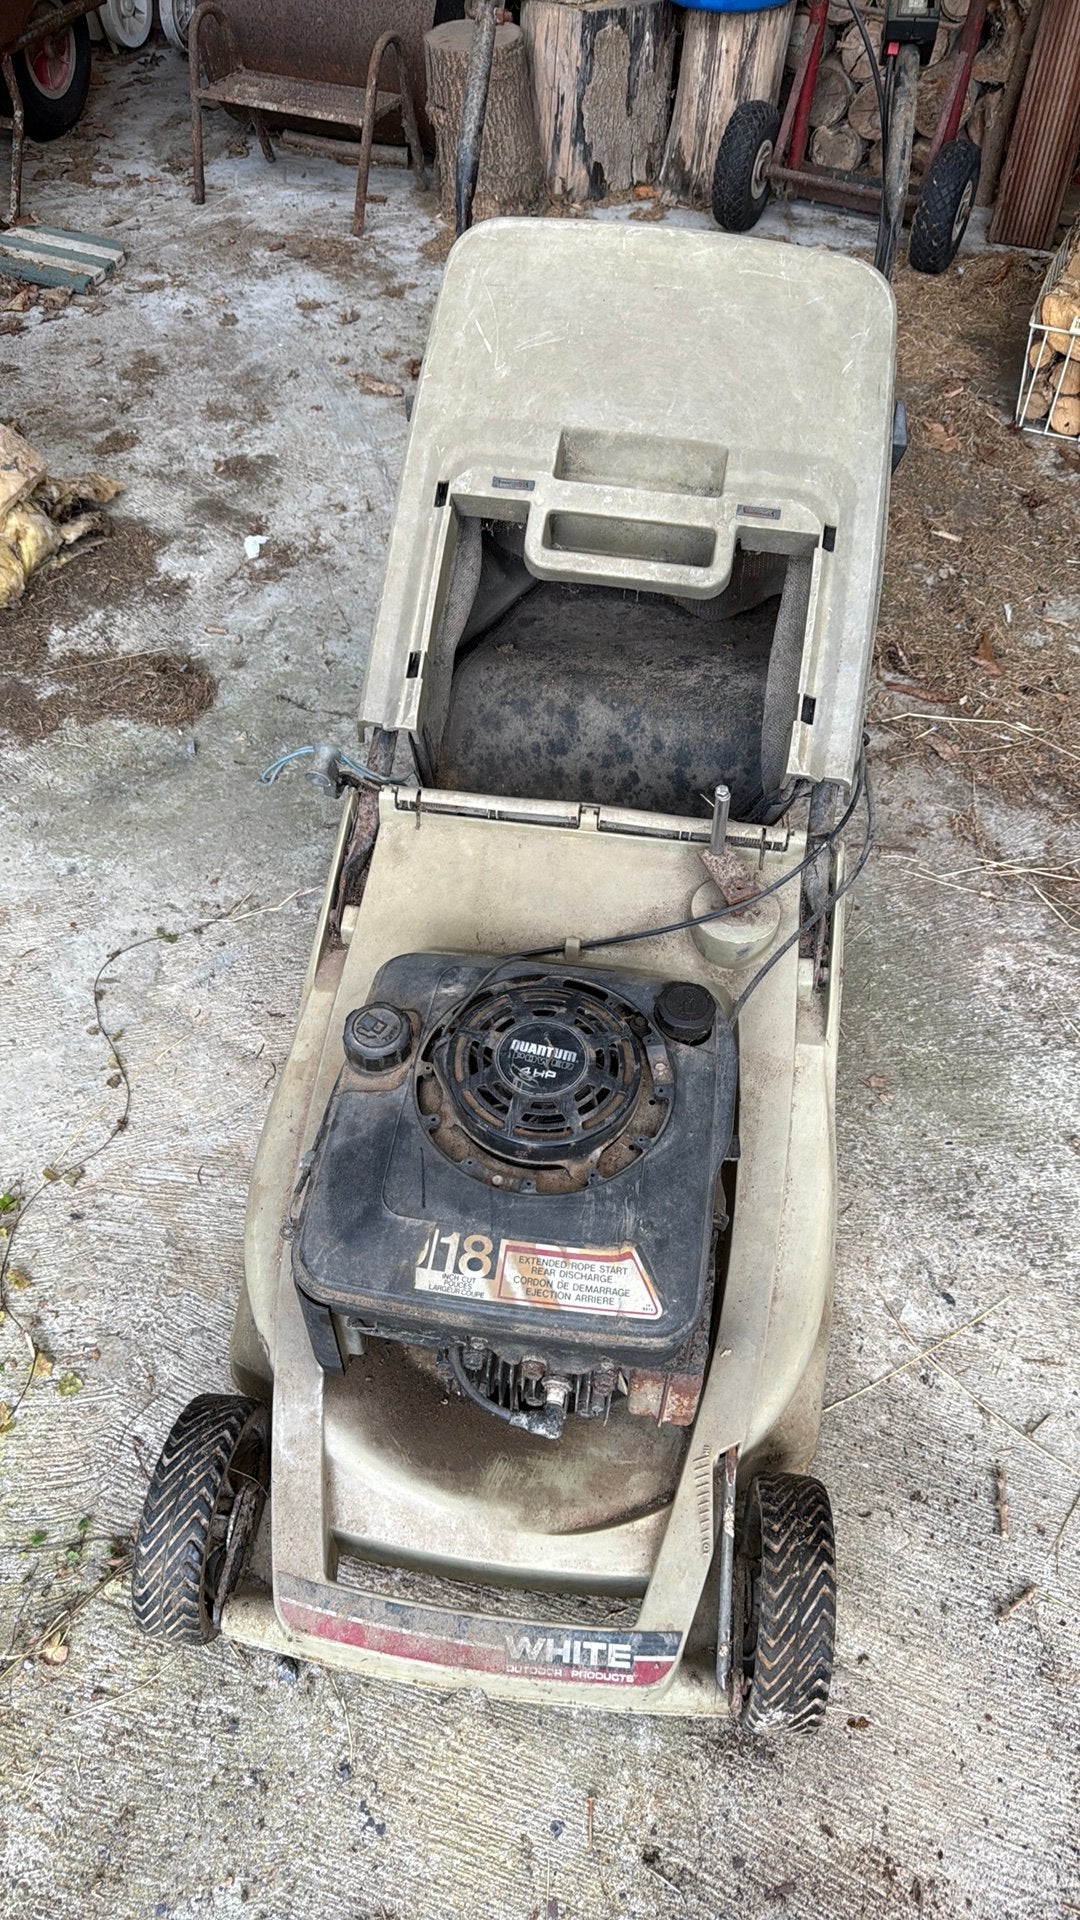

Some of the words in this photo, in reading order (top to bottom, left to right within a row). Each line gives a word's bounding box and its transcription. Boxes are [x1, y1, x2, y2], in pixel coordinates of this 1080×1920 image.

[510, 1039, 578, 1063] QUANTUM
[518, 1255, 568, 1269] EXTENDED
[571, 1261, 597, 1273] ROPE
[599, 1264, 629, 1276] START
[462, 1276, 476, 1284] CUT
[531, 1266, 556, 1277] REAR
[559, 1269, 613, 1284] DISCHARGE
[429, 1284, 461, 1295] LARGEUR
[461, 1290, 485, 1298] COUPE
[444, 1280, 473, 1290] POUCES
[513, 1275, 554, 1289] CORDON
[556, 1280, 570, 1291] DE
[572, 1283, 631, 1298] DEMARRAGE
[525, 1287, 572, 1301] EJECTION
[575, 1294, 615, 1306] ARRIERE
[505, 1635, 632, 1669] WHITE
[506, 1665, 563, 1677] OUTDOOR
[571, 1670, 635, 1683] PRODUCTS
